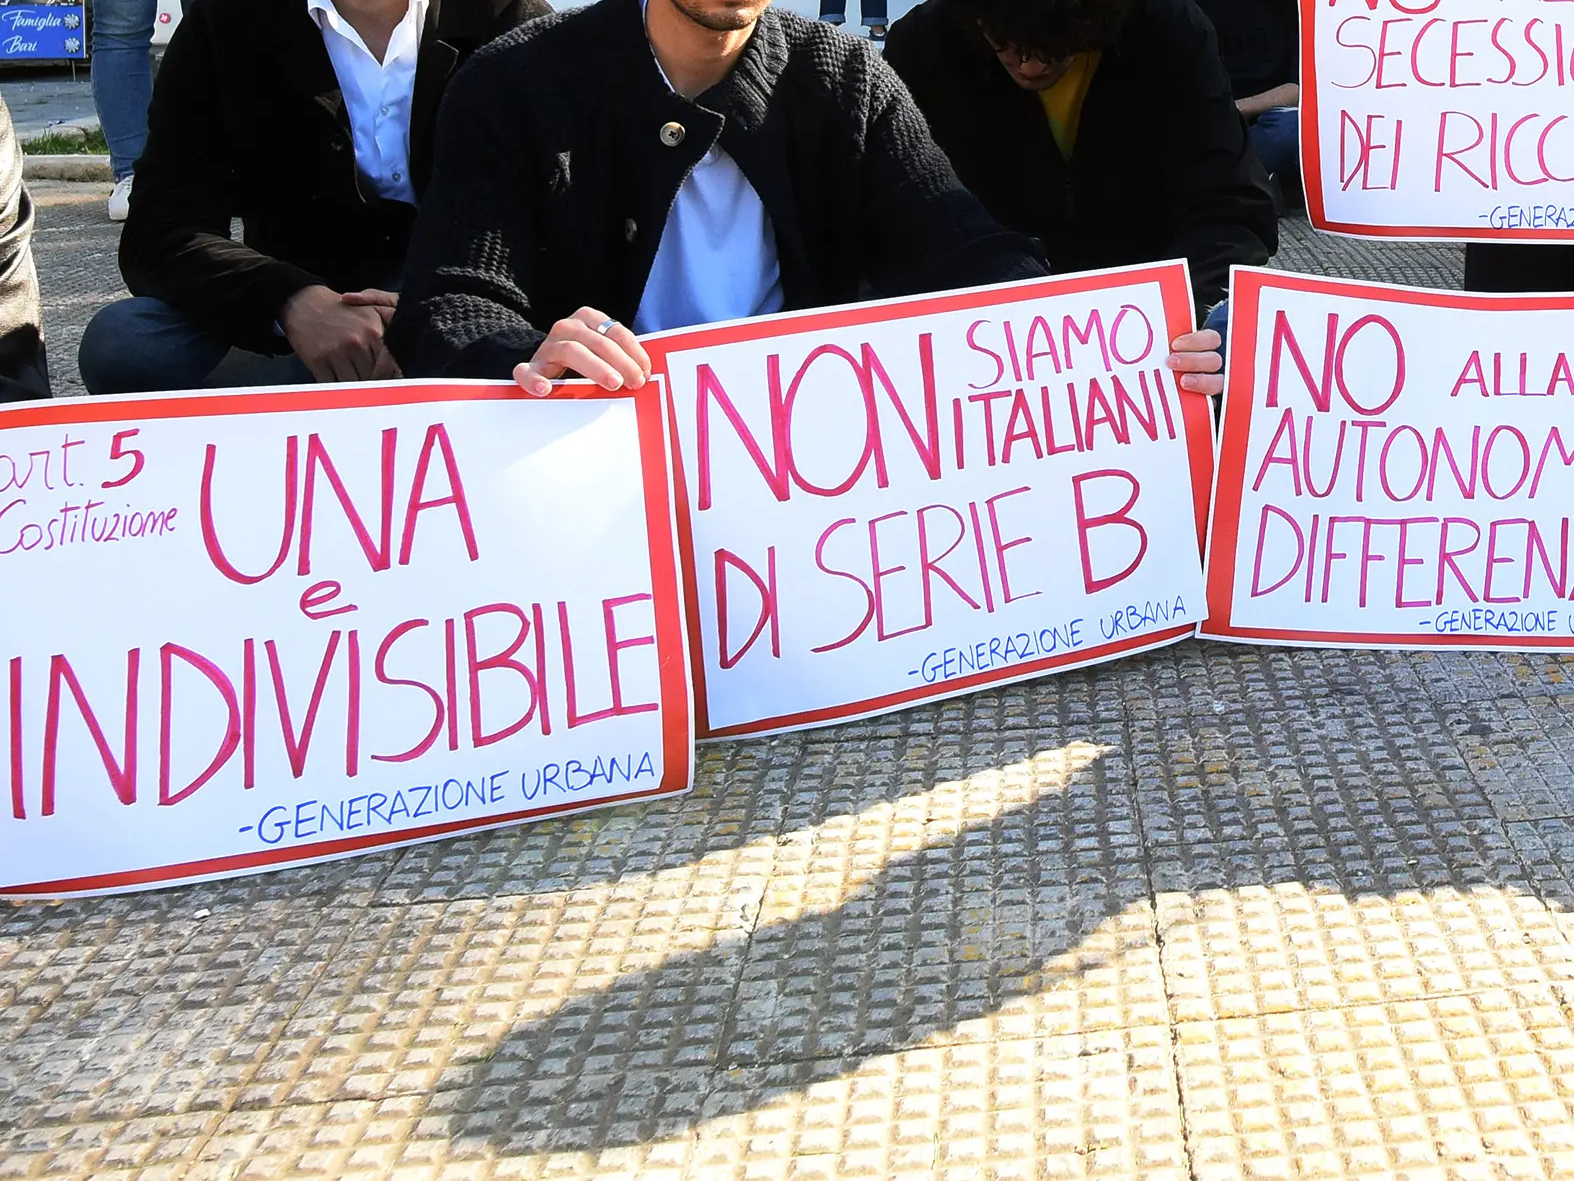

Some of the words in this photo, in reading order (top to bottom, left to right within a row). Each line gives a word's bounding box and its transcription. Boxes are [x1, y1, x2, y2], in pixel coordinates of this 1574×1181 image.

[2, 9, 61, 31] Famiglia
[2, 35, 37, 54] Bari
[1340, 109, 1401, 192] DEI
[966, 304, 1154, 390] SIAMO
[1265, 309, 1405, 417] NO
[0, 433, 86, 493] art.
[101, 428, 145, 489] 5
[696, 332, 942, 510] NON
[952, 368, 1177, 471] ITALIANI
[200, 422, 479, 585] UNA
[300, 580, 358, 620] e
[714, 545, 780, 670] DI
[811, 485, 1043, 653] SERIE
[1072, 468, 1148, 595] B
[1099, 594, 1187, 647] URBANA
[8, 592, 660, 820] INDIVISIBILE
[520, 751, 656, 800] URBANA
